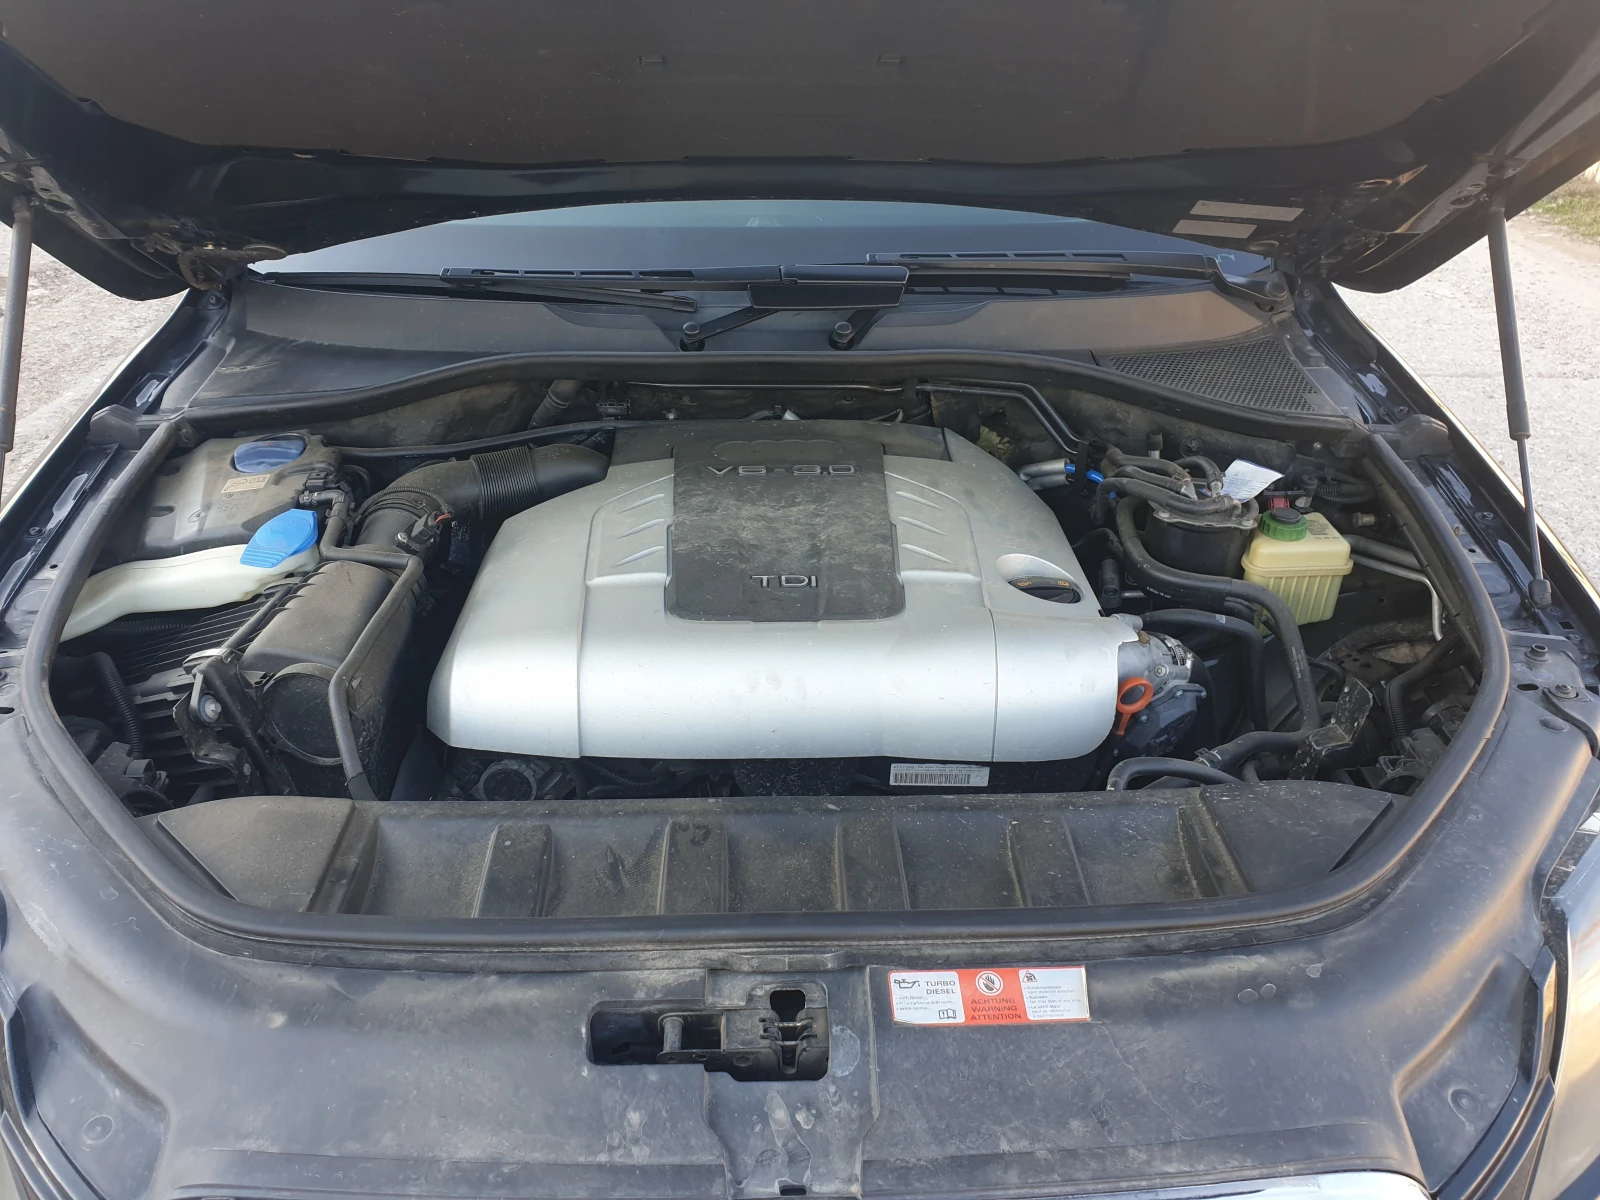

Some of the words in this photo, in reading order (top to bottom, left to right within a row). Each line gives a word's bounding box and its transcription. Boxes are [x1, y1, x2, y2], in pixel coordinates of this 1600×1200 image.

[707, 464, 767, 476] V6
[792, 464, 856, 476] 3.0
[751, 574, 818, 588] TDI
[970, 997, 1016, 1005] ACHTUNG
[971, 1005, 1018, 1013] WARNING
[970, 1013, 1022, 1021] ATTENTION
